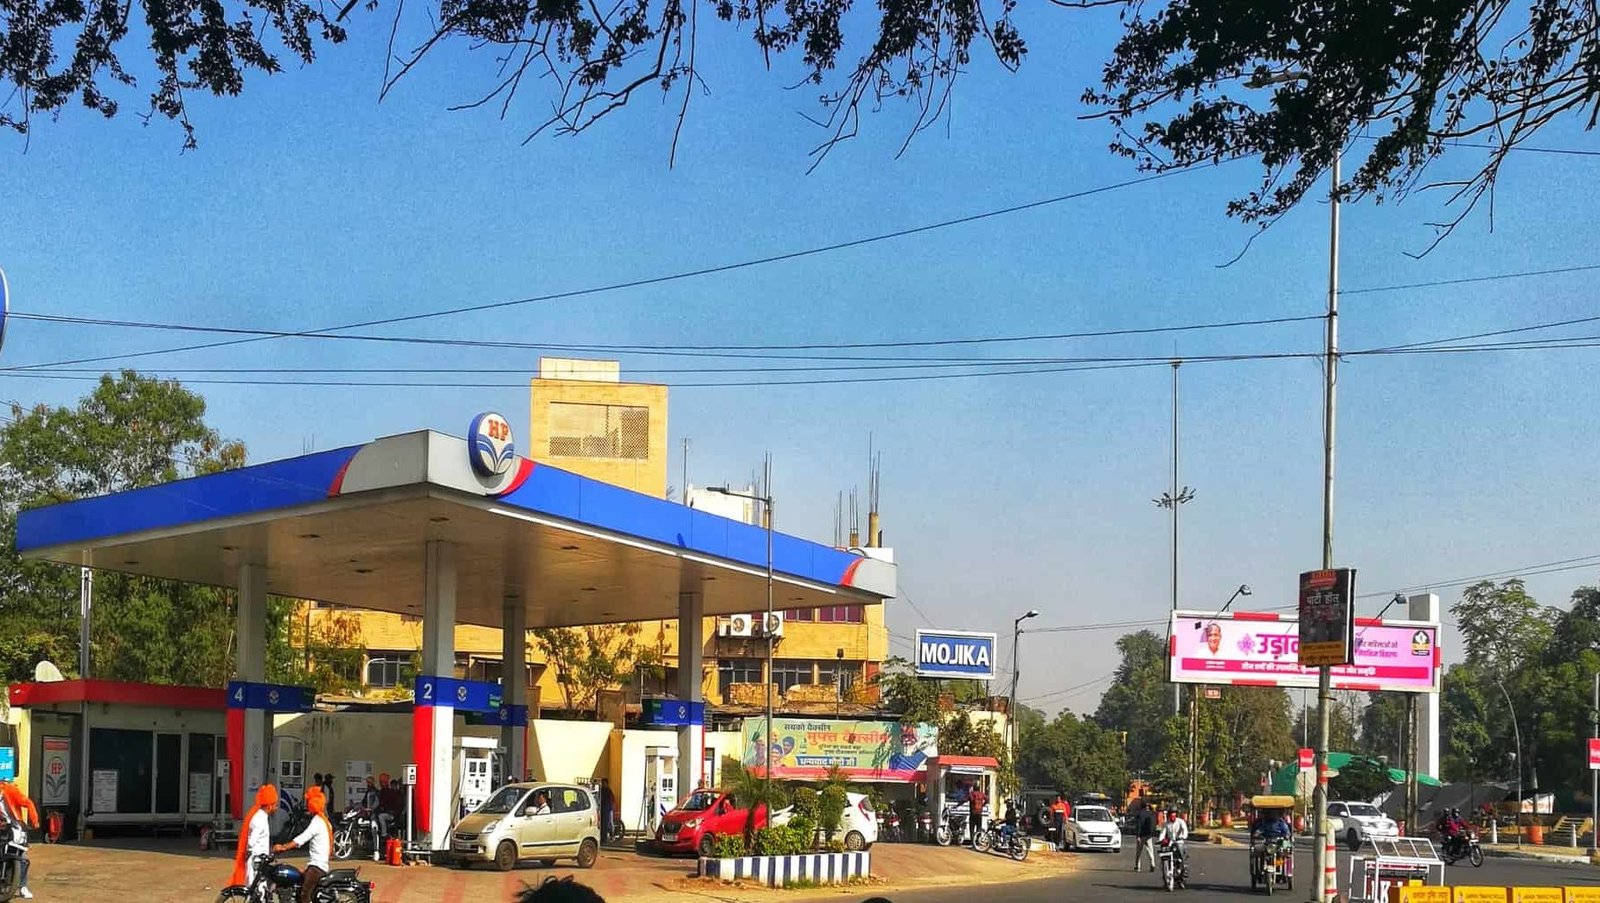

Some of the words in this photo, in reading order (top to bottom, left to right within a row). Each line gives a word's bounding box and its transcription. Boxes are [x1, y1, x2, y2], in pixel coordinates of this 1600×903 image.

[488, 419, 509, 441] HP
[921, 642, 990, 667] MOJIKA
[234, 687, 244, 702] 4
[423, 683, 432, 699] 2
[51, 762, 63, 775] HP
